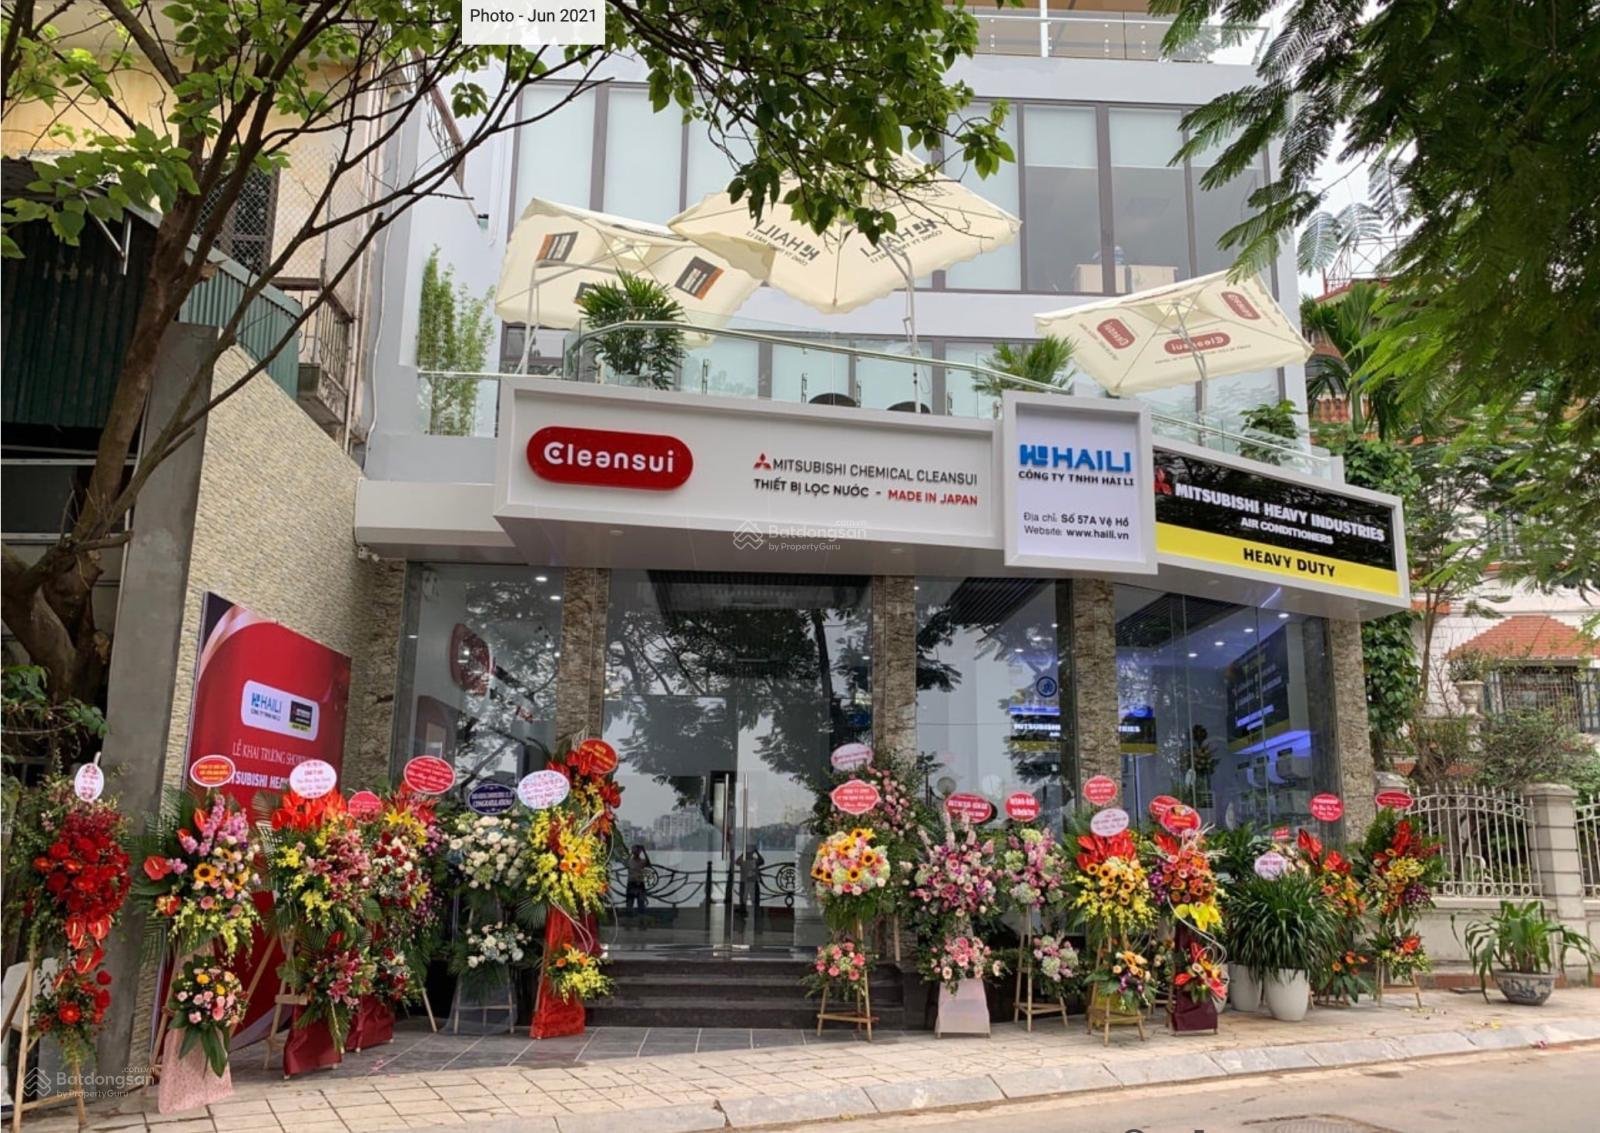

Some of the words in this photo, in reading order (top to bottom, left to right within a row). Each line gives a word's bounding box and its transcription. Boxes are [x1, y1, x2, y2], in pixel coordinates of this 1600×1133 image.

[543, 441, 674, 473] Cleansui
[1052, 446, 1131, 473] HAILI
[773, 458, 847, 476] MITSUBISHI
[850, 463, 914, 482] CHEMICAL
[916, 469, 978, 486] CLEANSUI
[1018, 469, 1049, 481] CÔNG
[1051, 472, 1065, 481] TY
[1068, 473, 1099, 484] TNHH
[1123, 477, 1134, 486] LI
[754, 477, 787, 491] THIẾT
[790, 481, 801, 495] BỊ
[805, 482, 830, 497] LỌC
[833, 483, 869, 497] NƯỚC
[888, 489, 922, 503] MADE
[925, 492, 937, 503] IN
[940, 493, 978, 506] JAPAN
[1077, 514, 1097, 525] 57A
[1175, 482, 1260, 514] MITSUBISHI
[1264, 501, 1308, 525] HEAVY
[1310, 513, 1385, 543] INDUSTRIES
[1066, 529, 1130, 540] www.haili.vn
[1240, 517, 1259, 530] AIR
[1260, 521, 1334, 545] CONDITIONERS
[1243, 547, 1292, 569] HEAVY
[1296, 558, 1335, 578] DUTY
